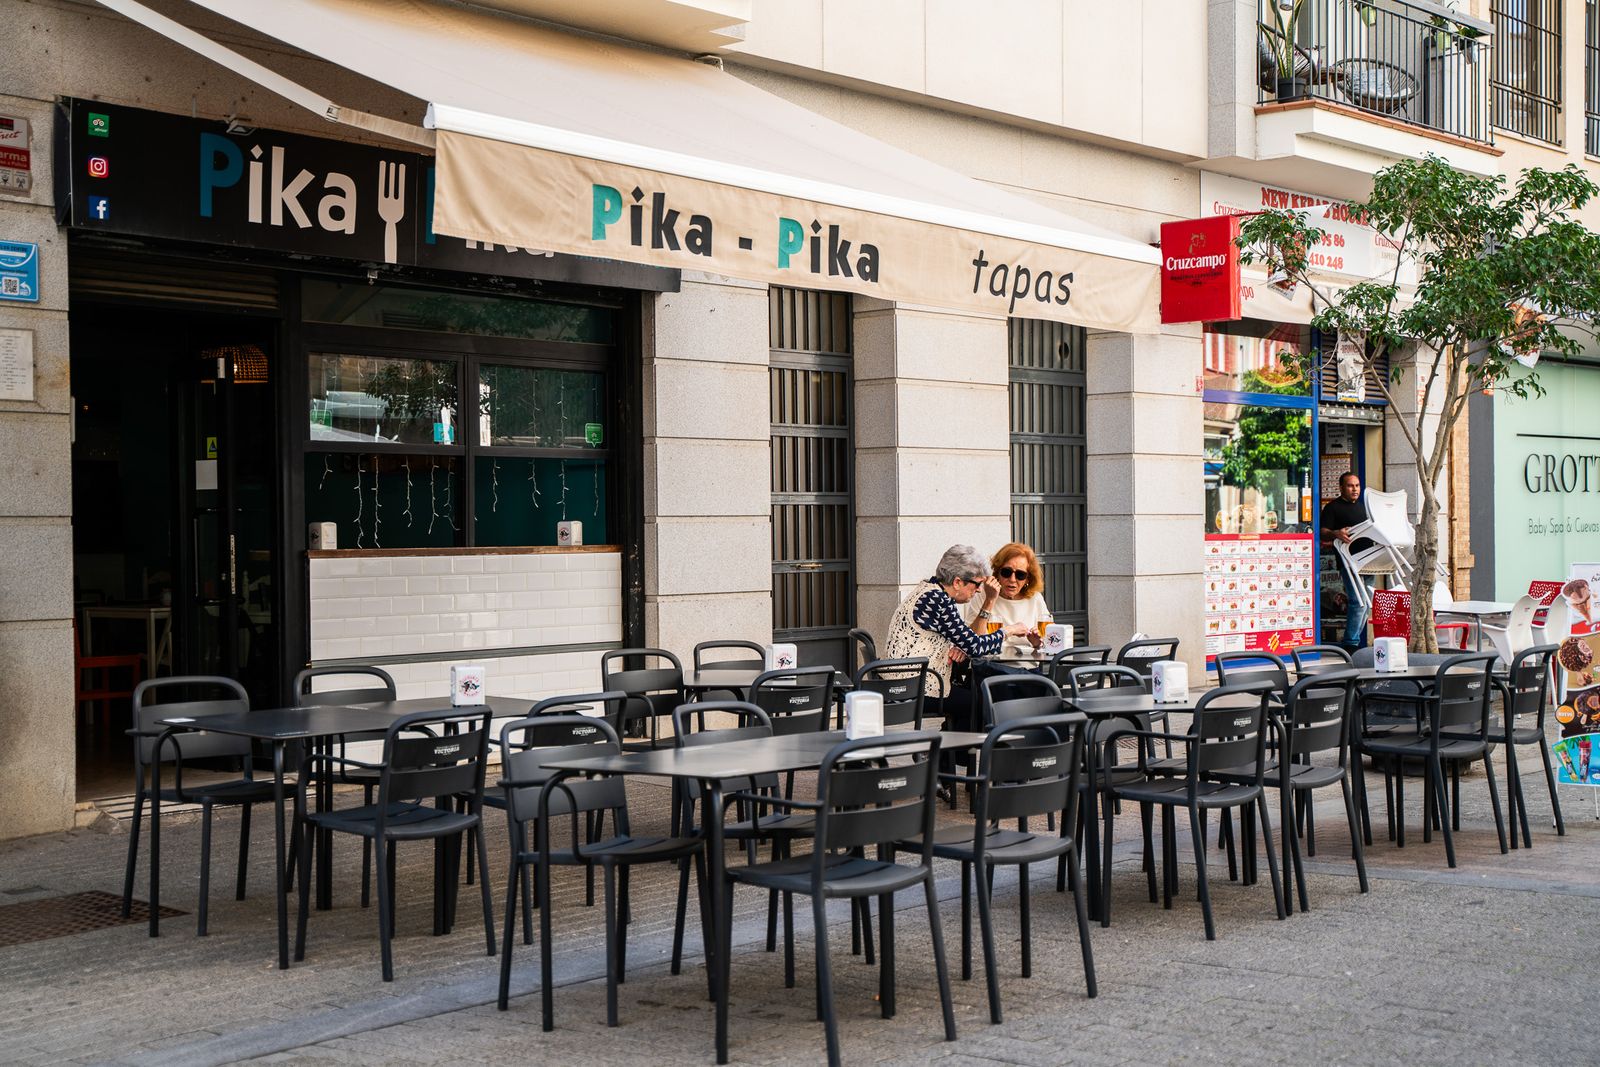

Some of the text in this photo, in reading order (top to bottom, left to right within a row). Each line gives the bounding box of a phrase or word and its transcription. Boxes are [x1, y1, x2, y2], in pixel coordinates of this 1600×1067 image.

[200, 132, 357, 235] Pika
[1261, 187, 1289, 209] NEW
[592, 184, 713, 257] Pika
[778, 217, 879, 283] Pika
[972, 250, 1074, 313] tapas
[1334, 233, 1345, 248] 86
[1166, 254, 1226, 271] Cruzcampo
[1326, 255, 1343, 270] 248
[1528, 516, 1600, 536] Baby Spa & Cuevas
